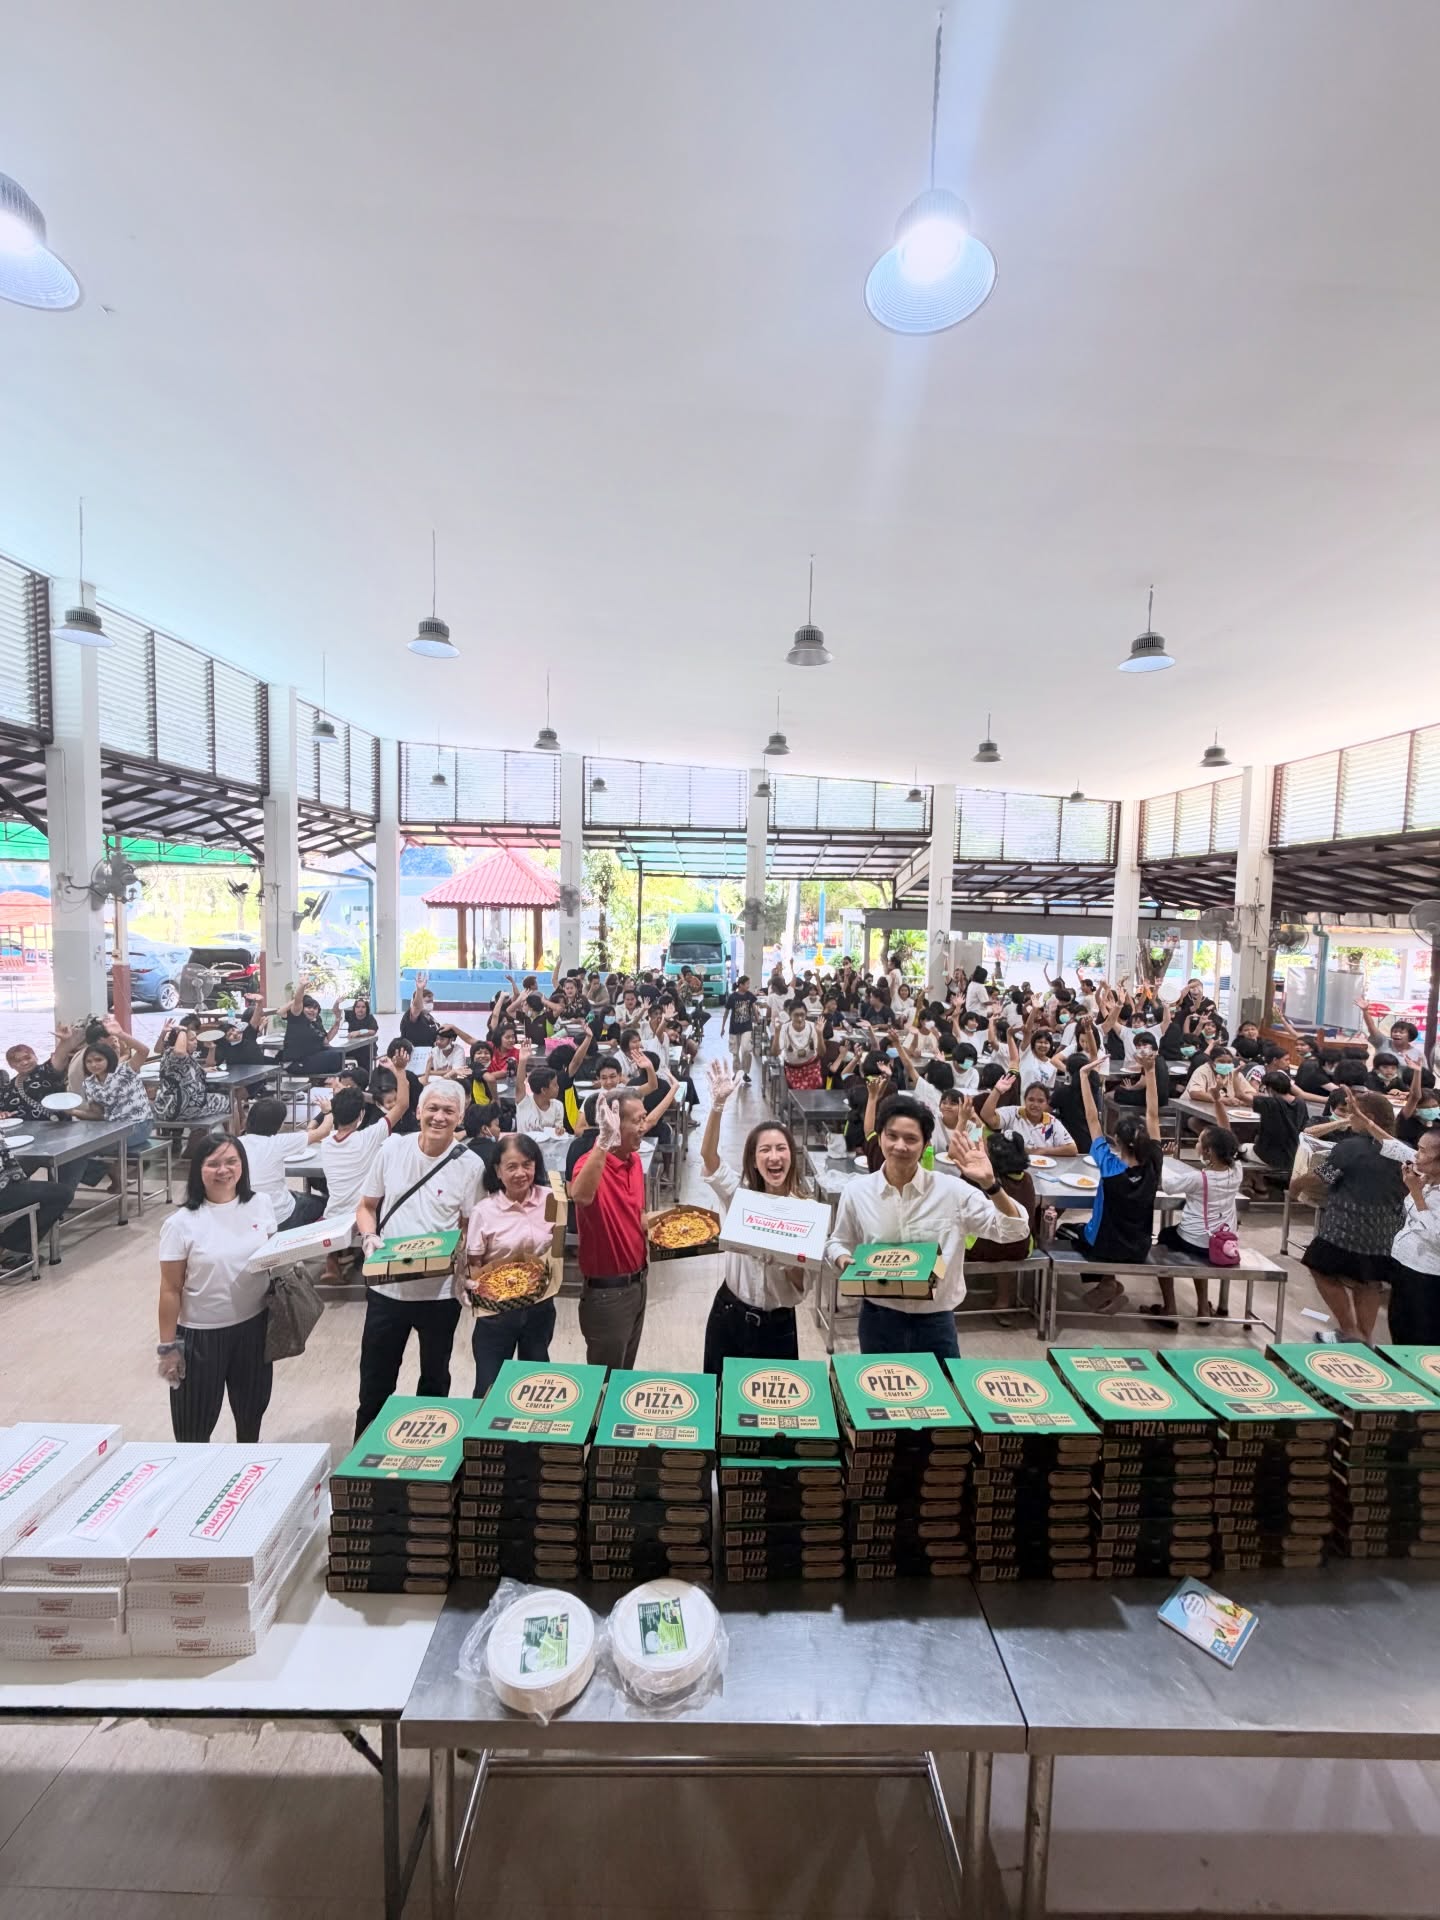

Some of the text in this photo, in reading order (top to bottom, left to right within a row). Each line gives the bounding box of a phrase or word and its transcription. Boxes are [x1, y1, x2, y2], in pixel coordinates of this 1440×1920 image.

[399, 1240, 435, 1250] PIZZA
[873, 1254, 911, 1263] PIZZA
[1318, 1363, 1371, 1378] PIZZA
[867, 1375, 918, 1391] PIZZA
[1206, 1371, 1258, 1386] PIZZA
[517, 1385, 567, 1402] PIZZA
[752, 1381, 799, 1398] PIZZA
[984, 1381, 1037, 1397] PIZZA
[1110, 1387, 1164, 1401] PIZZA
[634, 1392, 684, 1408] PIZZA
[395, 1421, 448, 1437] PIZZA
[1115, 1421, 1207, 1437] THE PIZZA COMPANY
[874, 1431, 897, 1444] 1112
[1000, 1438, 1023, 1449] 1112
[481, 1443, 504, 1455] 1112
[617, 1452, 639, 1462] 1112
[483, 1464, 506, 1475] 1112
[740, 1471, 763, 1481] 1112
[227, 1465, 266, 1500] Krispy
[350, 1481, 371, 1492] 1112
[351, 1497, 374, 1508] 1112
[480, 1503, 501, 1515] 1112
[608, 1508, 630, 1519] 1112
[201, 1499, 240, 1536] Kreme
[351, 1519, 373, 1529] 1112
[350, 1560, 371, 1570] 1112
